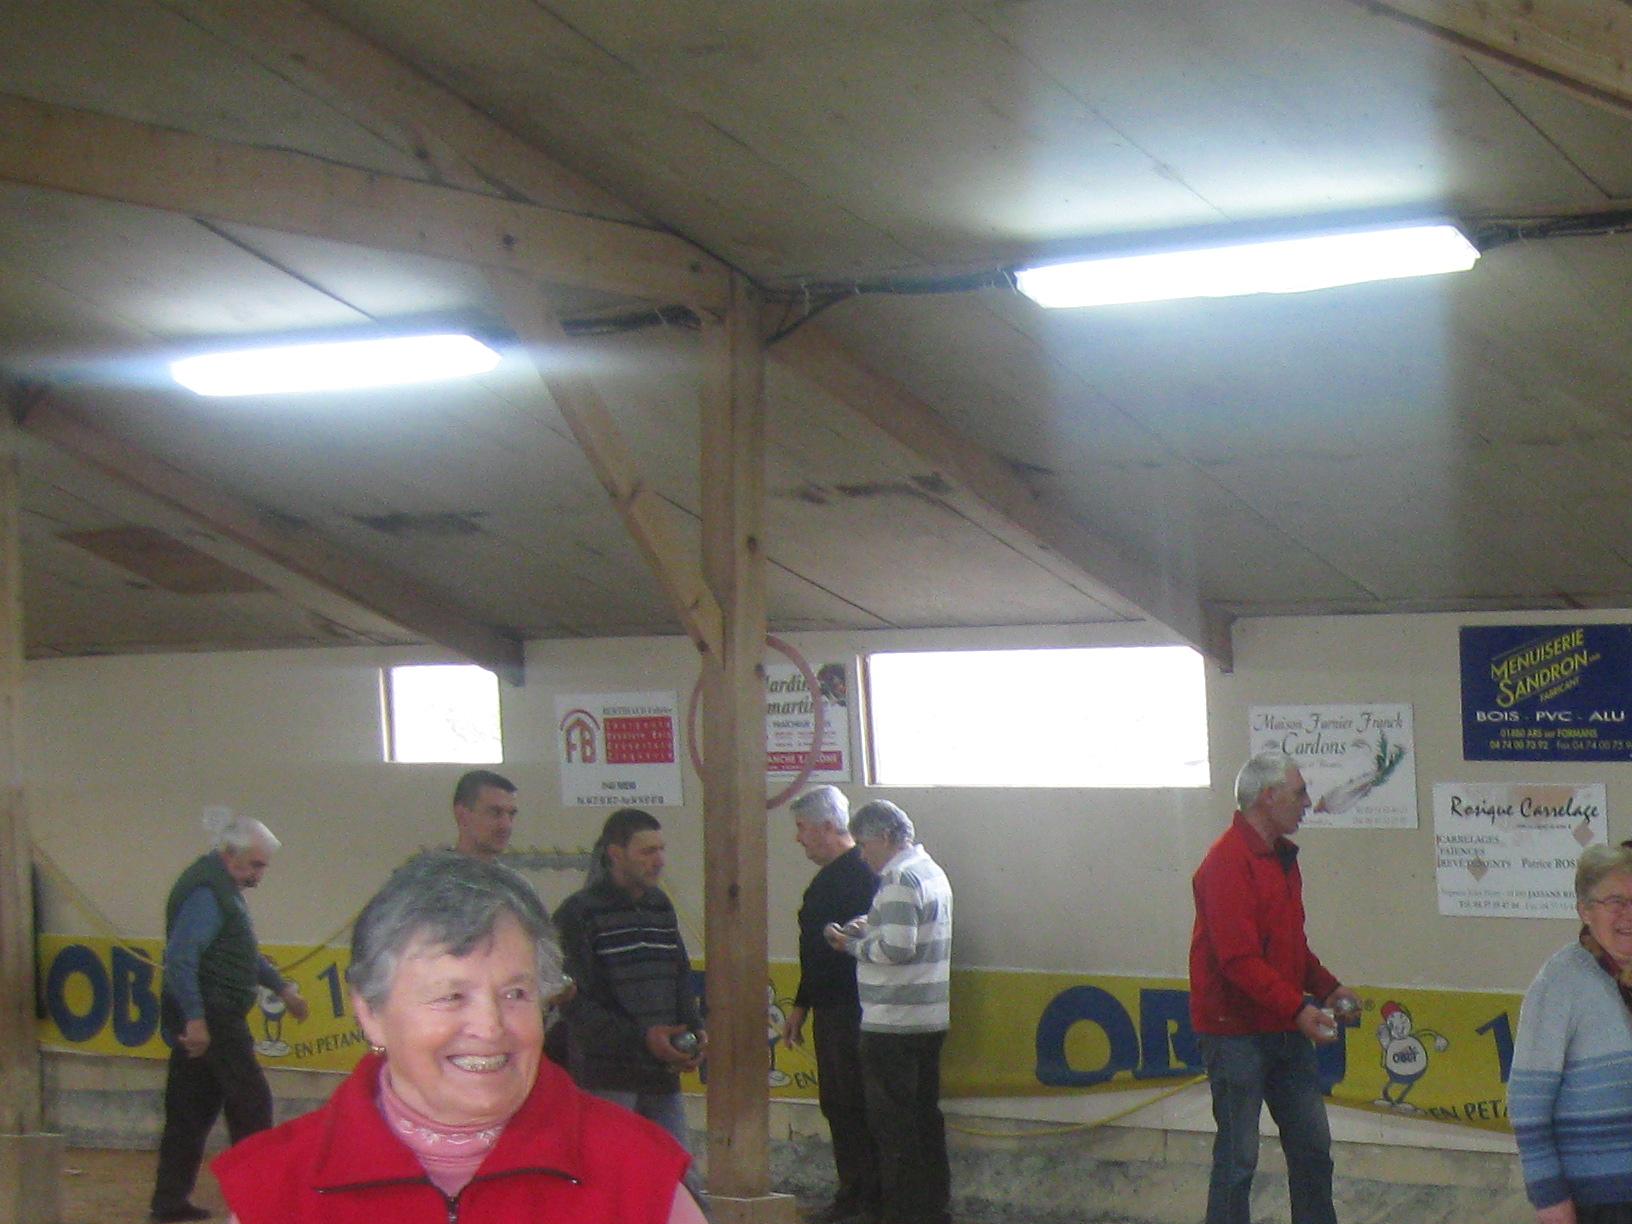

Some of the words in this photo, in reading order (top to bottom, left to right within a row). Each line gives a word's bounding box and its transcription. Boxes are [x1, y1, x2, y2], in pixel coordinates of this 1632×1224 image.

[1491, 628, 1585, 680] MENUISERIE
[1496, 650, 1589, 707] SANDRON
[1476, 711, 1520, 722] BOIS
[1536, 711, 1572, 722] PVC
[1589, 711, 1625, 722] ALU
[1282, 732, 1346, 755] Cardons
[1557, 728, 1599, 738] FORMANS
[1451, 795, 1513, 826] Rosique
[1520, 797, 1600, 824] Carrelage
